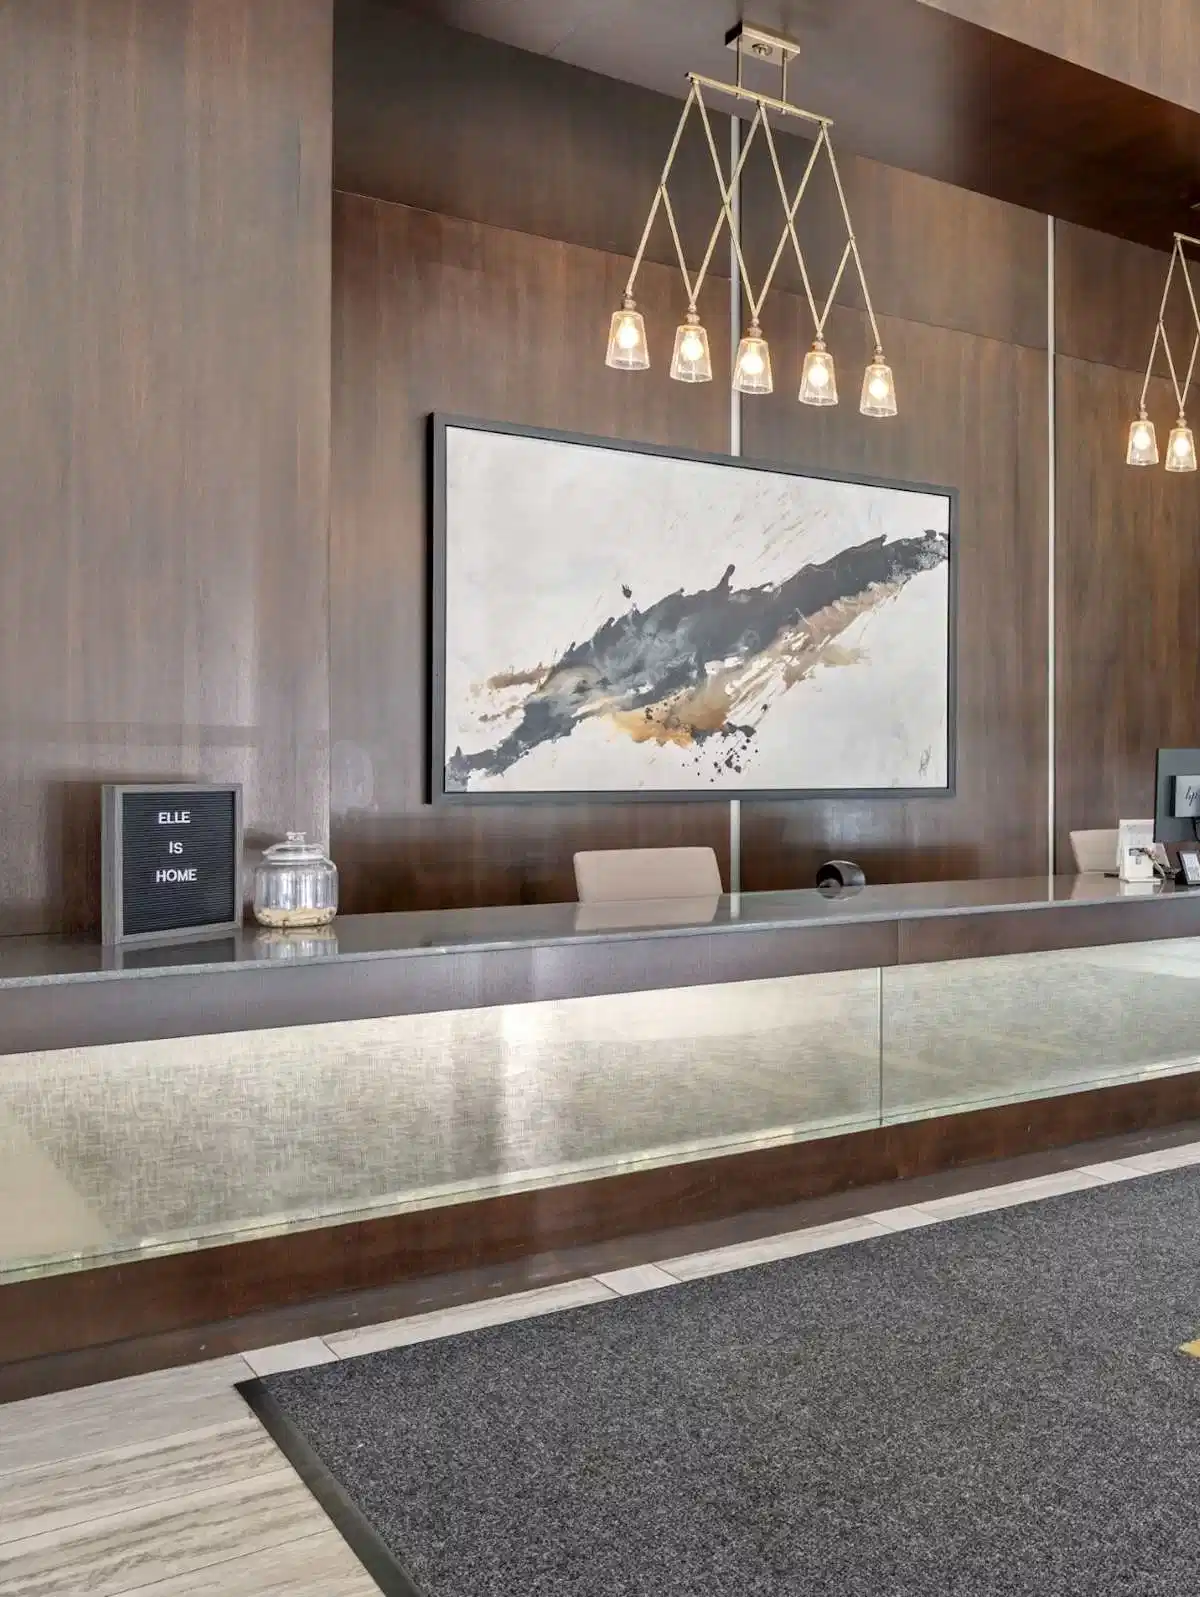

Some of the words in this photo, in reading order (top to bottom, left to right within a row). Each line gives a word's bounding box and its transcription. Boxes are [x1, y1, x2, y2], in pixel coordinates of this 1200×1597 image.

[158, 811, 191, 824] ELLE
[169, 841, 183, 854] IS
[156, 868, 198, 882] HOME
